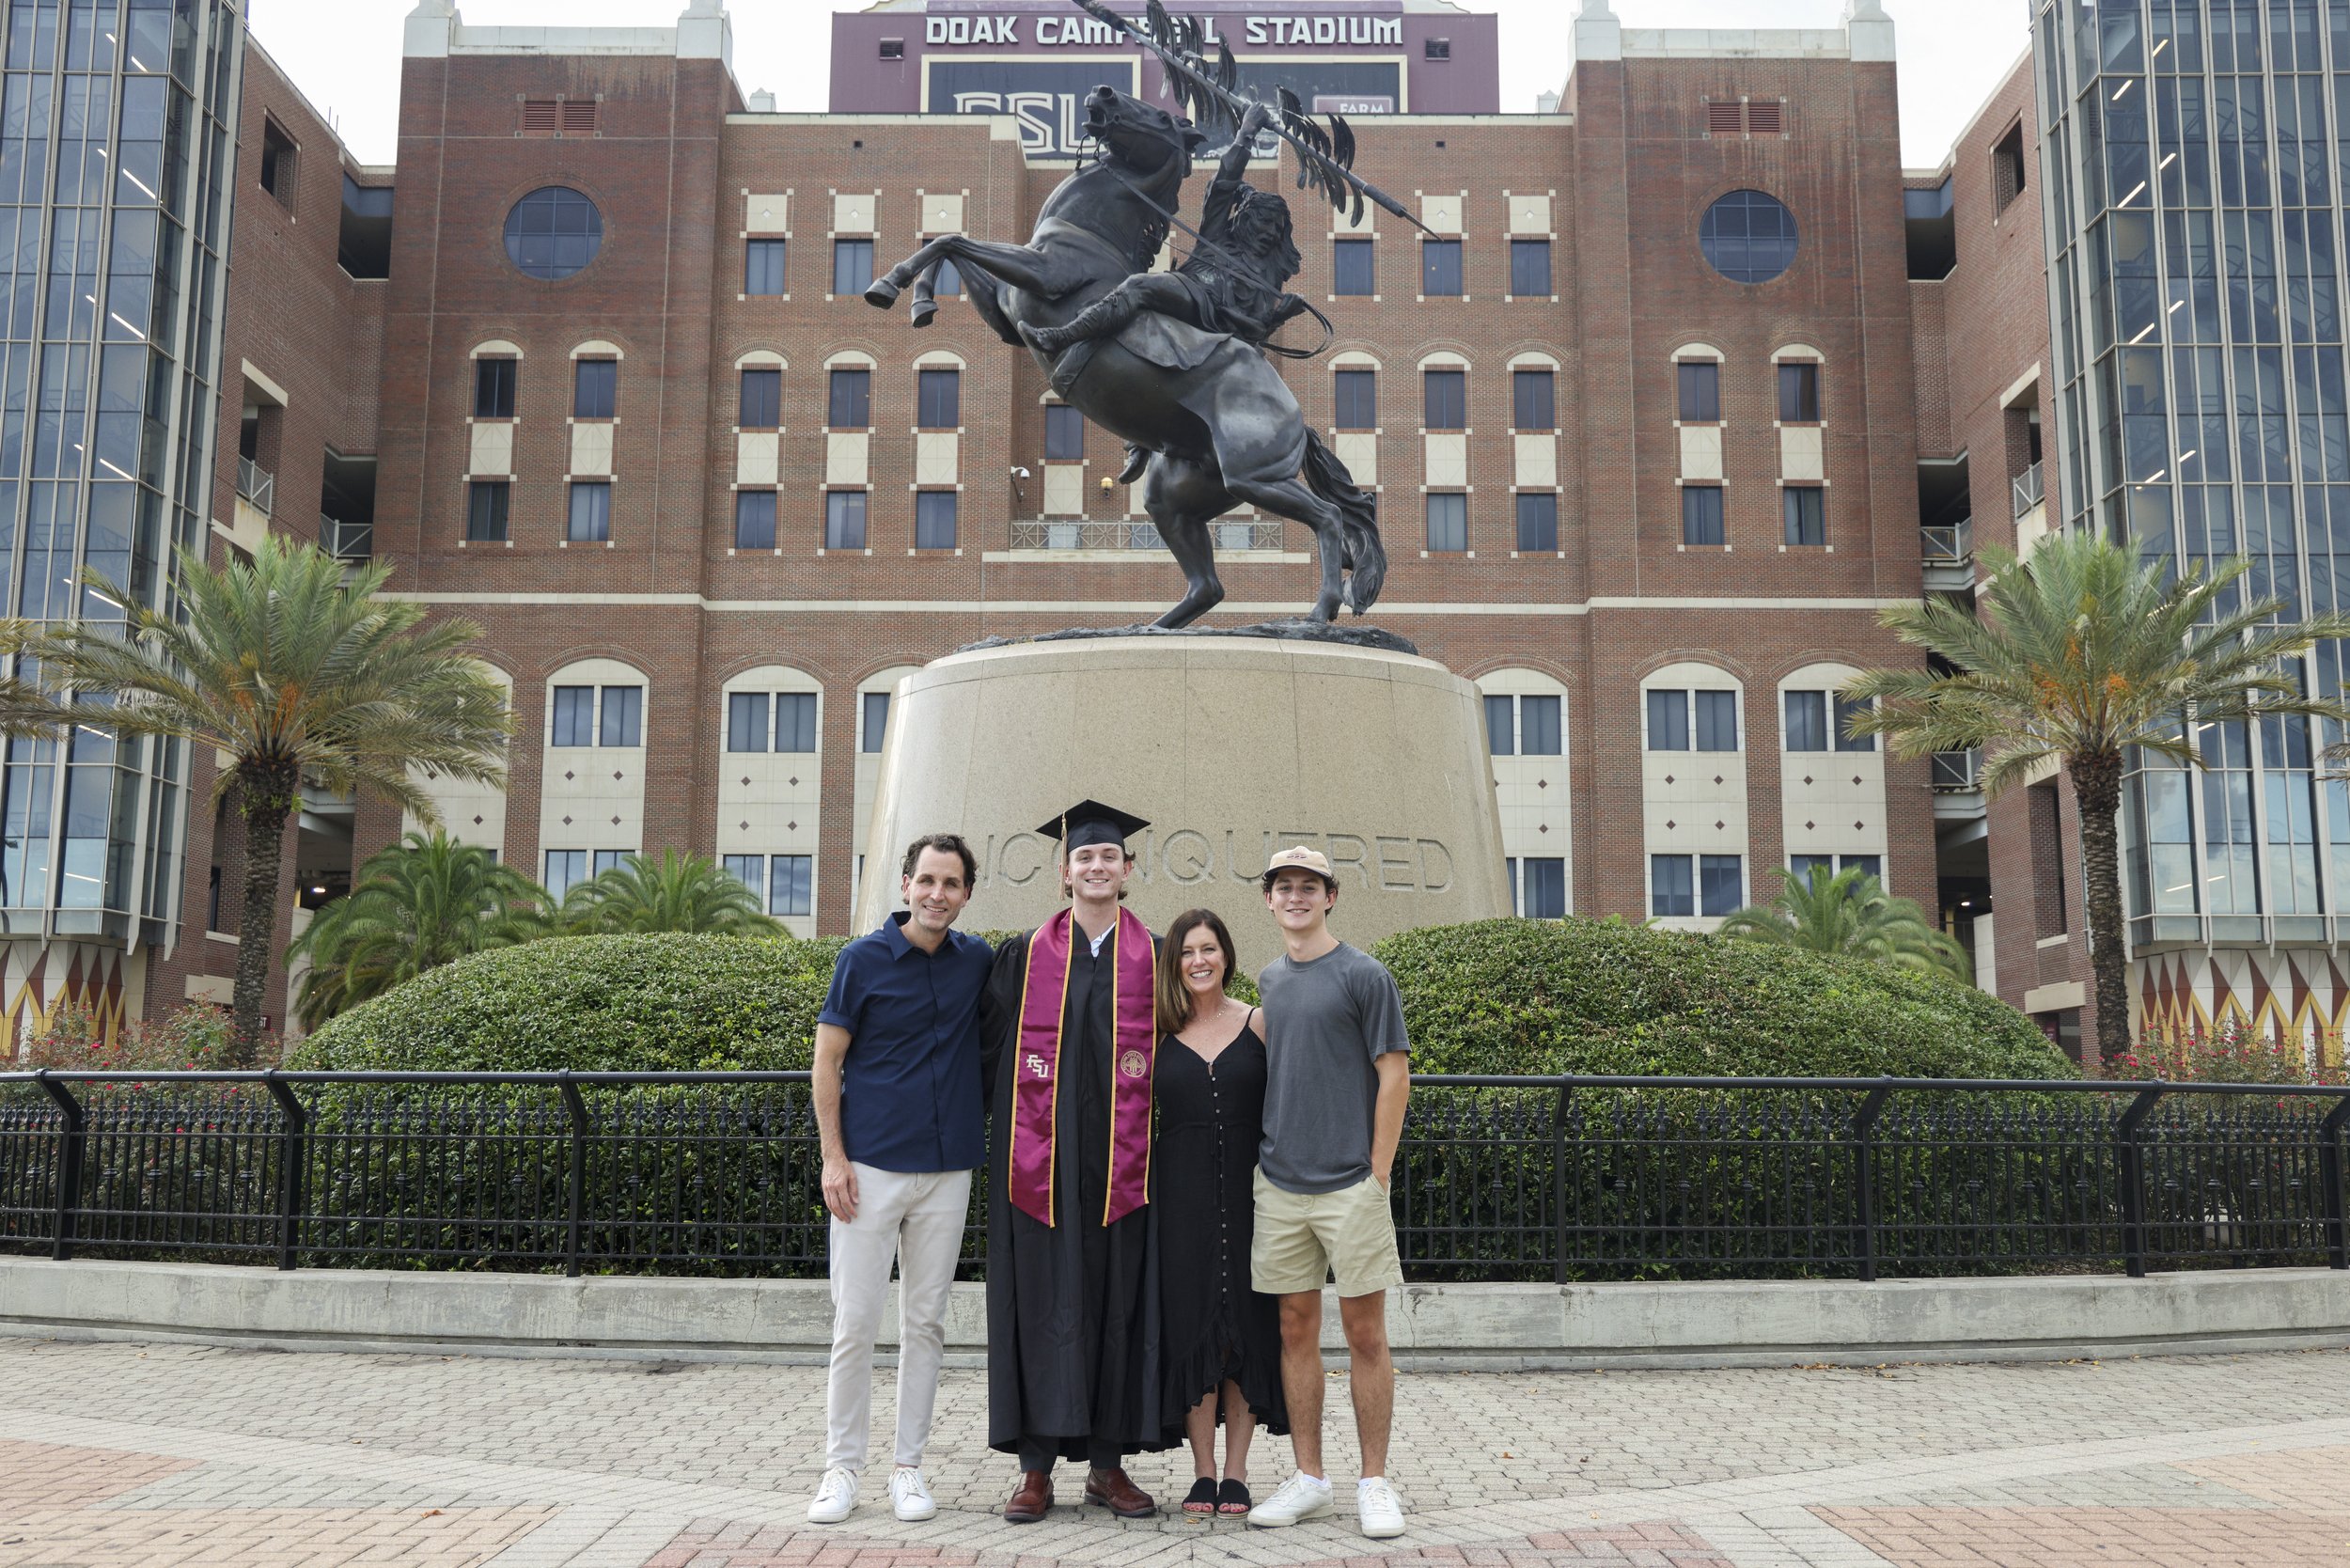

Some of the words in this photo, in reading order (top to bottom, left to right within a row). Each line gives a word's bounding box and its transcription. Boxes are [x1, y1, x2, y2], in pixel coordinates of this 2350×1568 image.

[925, 16, 1019, 44] DOAK
[1036, 16, 1220, 44] CAMPEL
[1246, 16, 1403, 44] STADIUM
[1026, 1054, 1049, 1078] FSU
